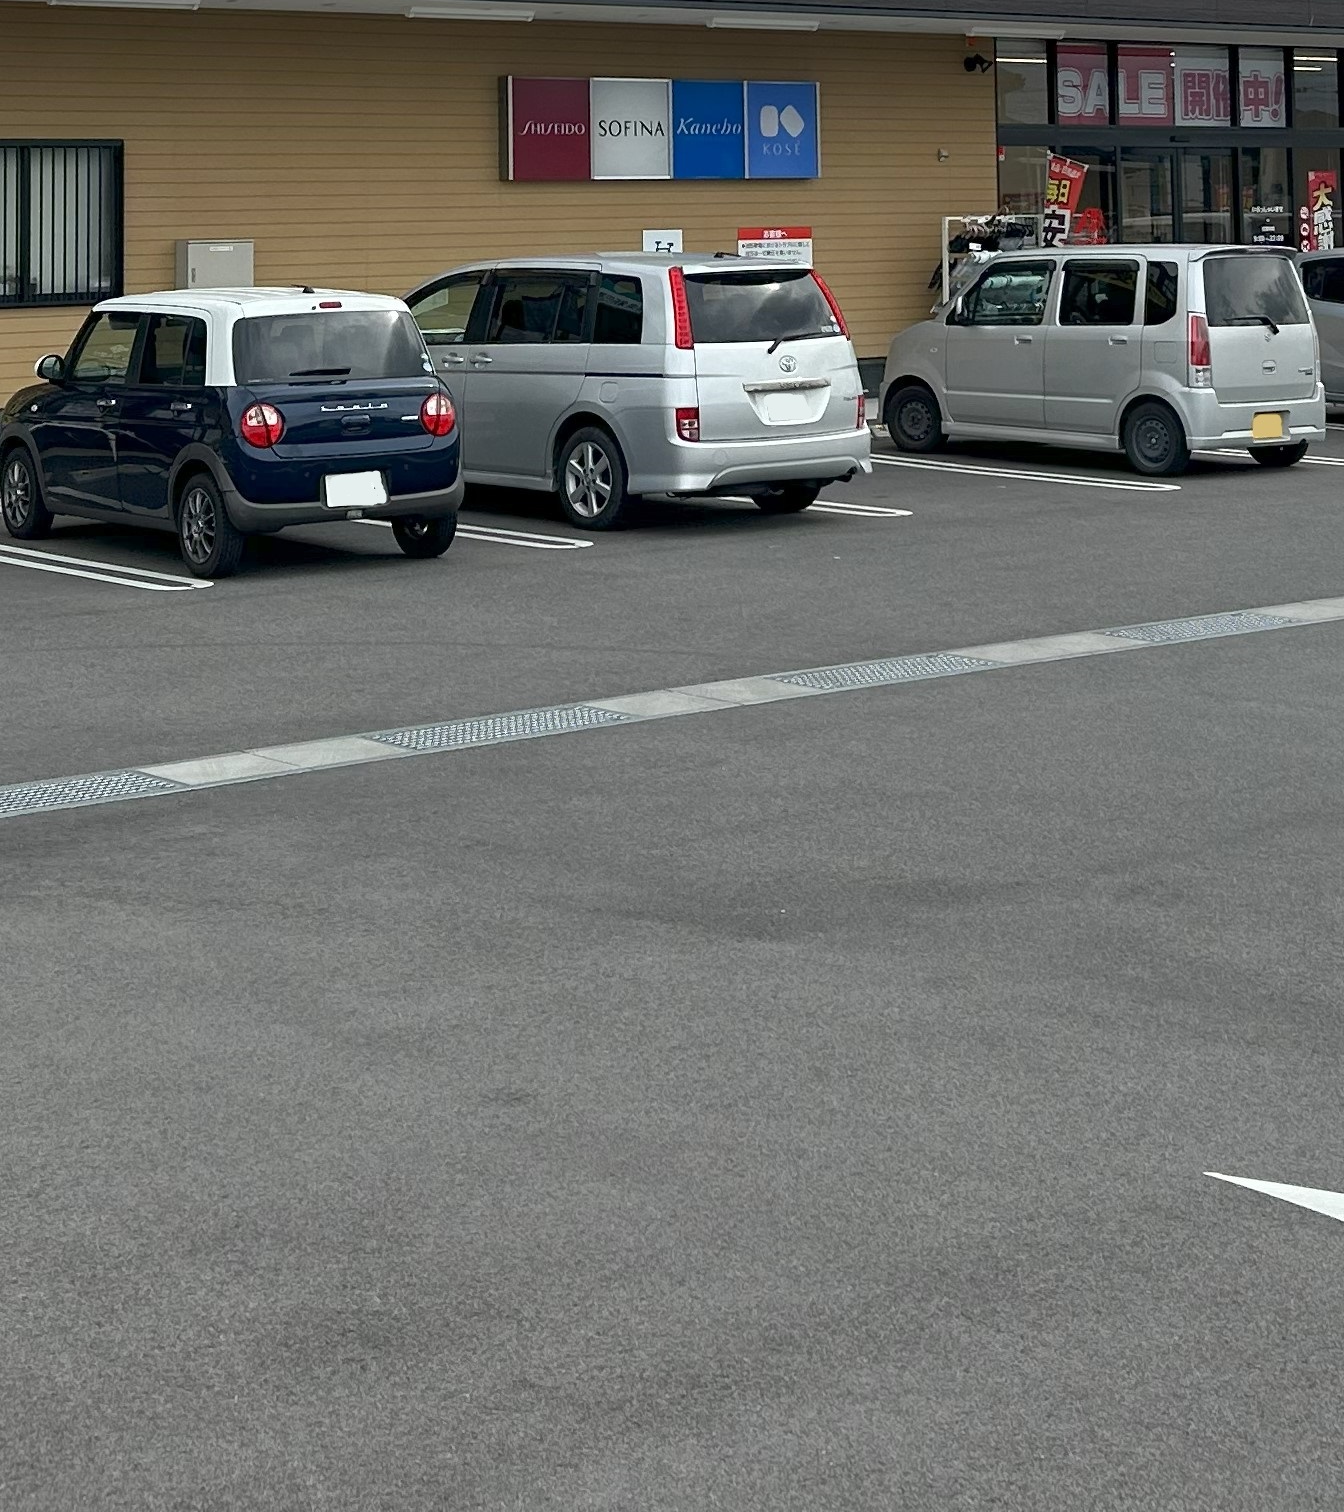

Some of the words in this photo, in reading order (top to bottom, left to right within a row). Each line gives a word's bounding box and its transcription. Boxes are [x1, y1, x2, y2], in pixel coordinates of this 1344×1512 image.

[1057, 68, 1167, 117] SALE
[519, 120, 585, 135] SHISEIDO
[598, 120, 665, 137] SOFINA
[676, 117, 742, 135] Kanebo
[762, 140, 801, 156] KOSÉ
